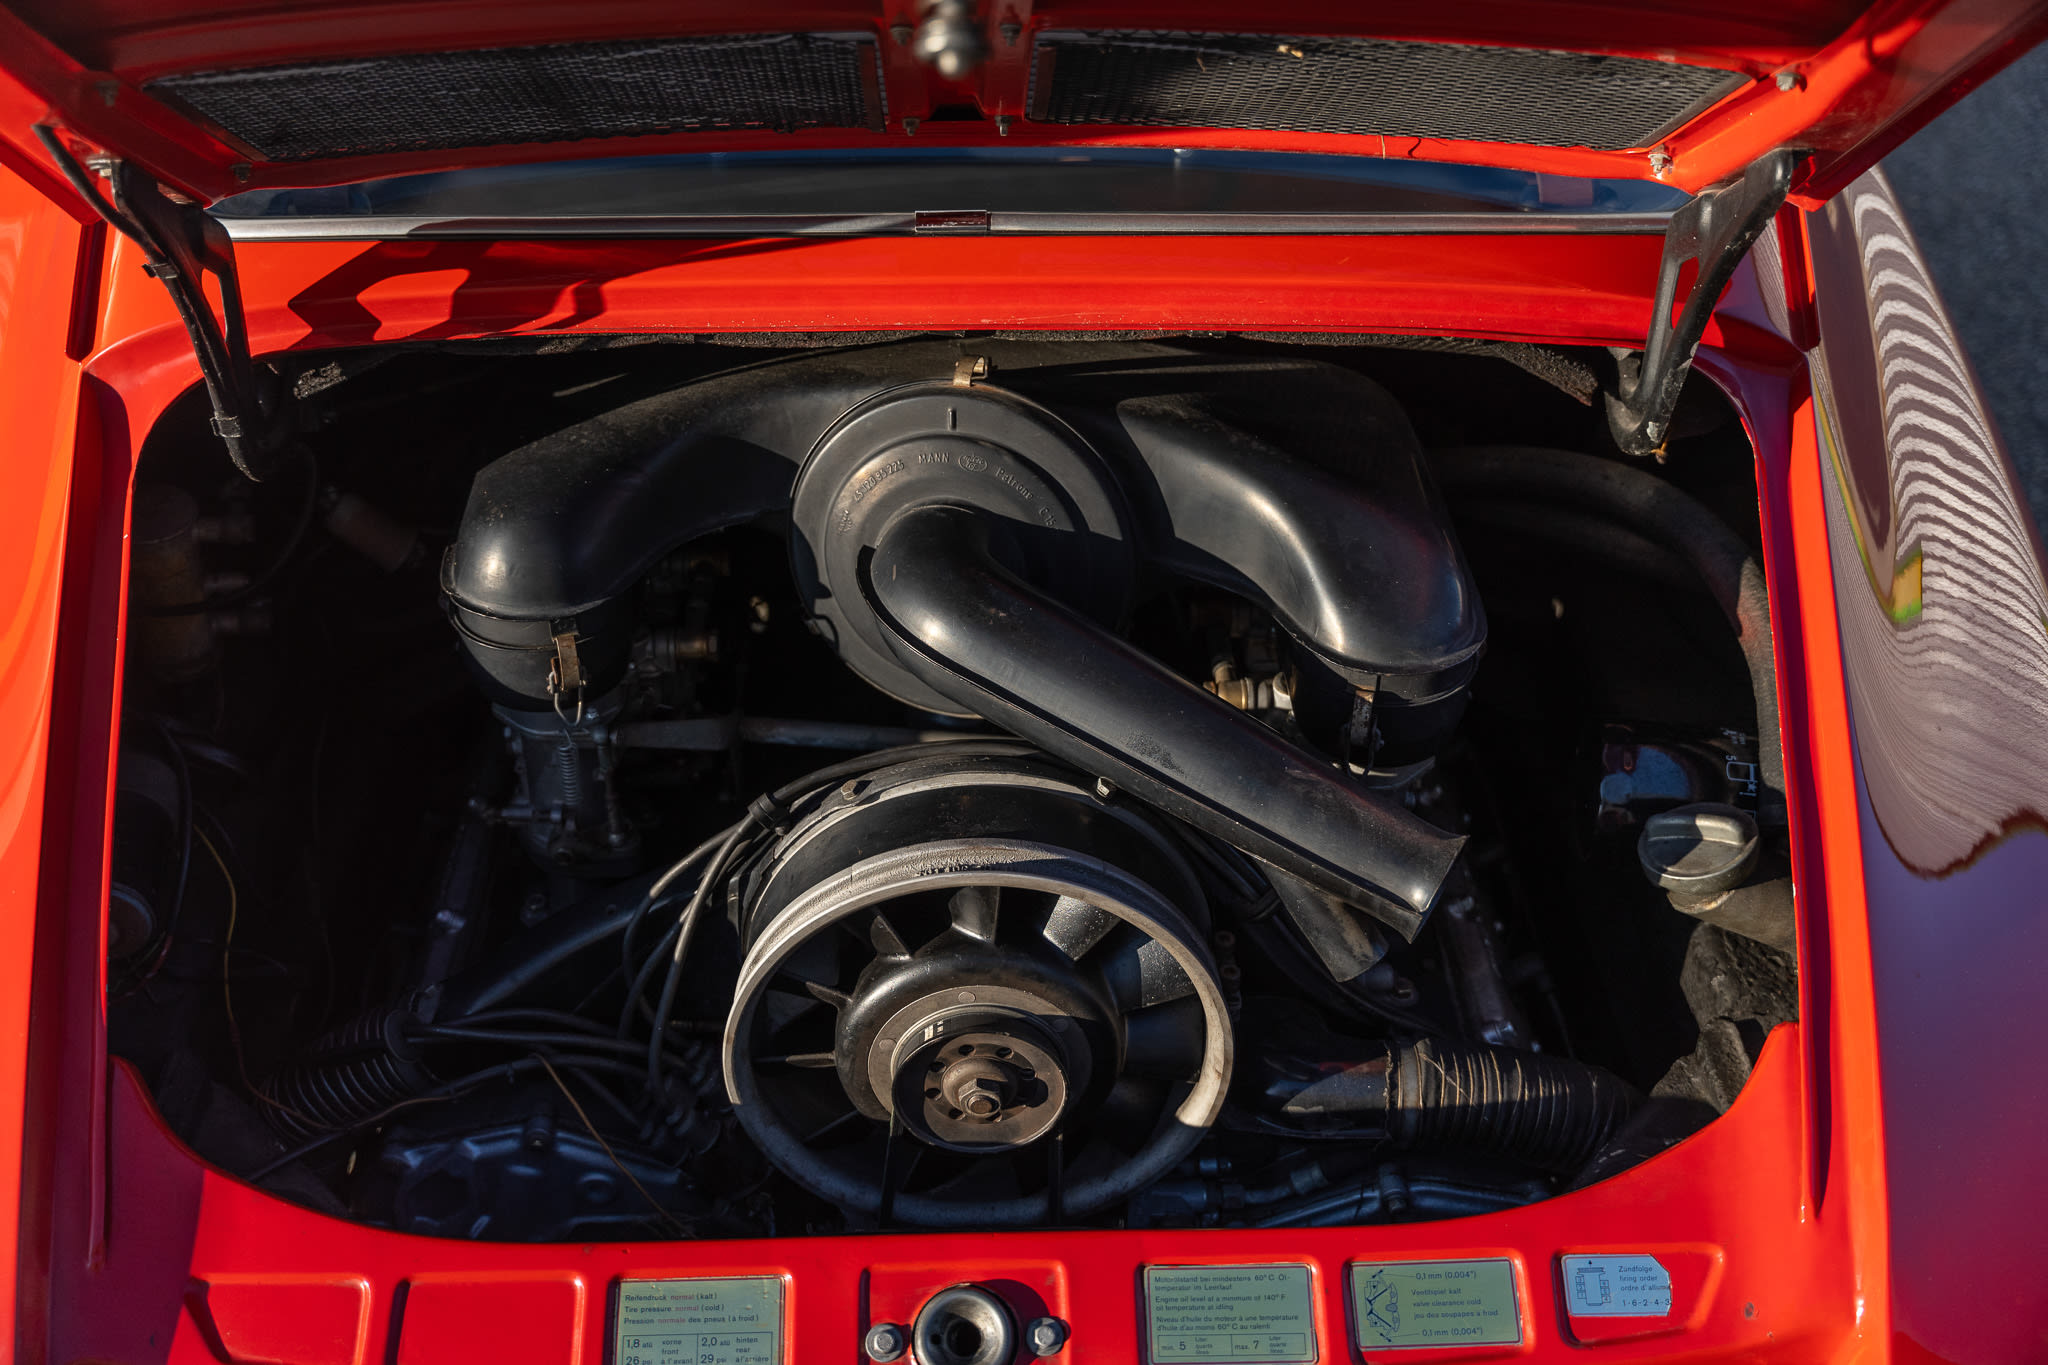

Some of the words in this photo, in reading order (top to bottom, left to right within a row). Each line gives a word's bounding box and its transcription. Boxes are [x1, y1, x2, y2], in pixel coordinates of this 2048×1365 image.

[918, 452, 950, 465] MANN
[995, 466, 1034, 501] Patrone
[1415, 1272, 1426, 1280] 0,1
[1619, 1275, 1637, 1283] firing
[1204, 1283, 1232, 1291] Leerlauf
[1448, 1287, 1461, 1295] kalt
[1155, 1296, 1178, 1304] Engine
[1165, 1304, 1206, 1312] temperature
[1215, 1303, 1234, 1311] idling
[1414, 1312, 1424, 1320] jeu
[1441, 1311, 1474, 1319] soupapes
[1157, 1323, 1179, 1331] d'huile
[1231, 1322, 1238, 1330] C
[1422, 1328, 1433, 1337] 0,1
[626, 1338, 641, 1349] 1,8
[701, 1336, 718, 1348] 2,0
[735, 1336, 759, 1344] hinten
[1252, 1339, 1260, 1350] 7
[1179, 1341, 1186, 1351] 5
[626, 1355, 640, 1365] 26
[700, 1353, 714, 1364] 29
